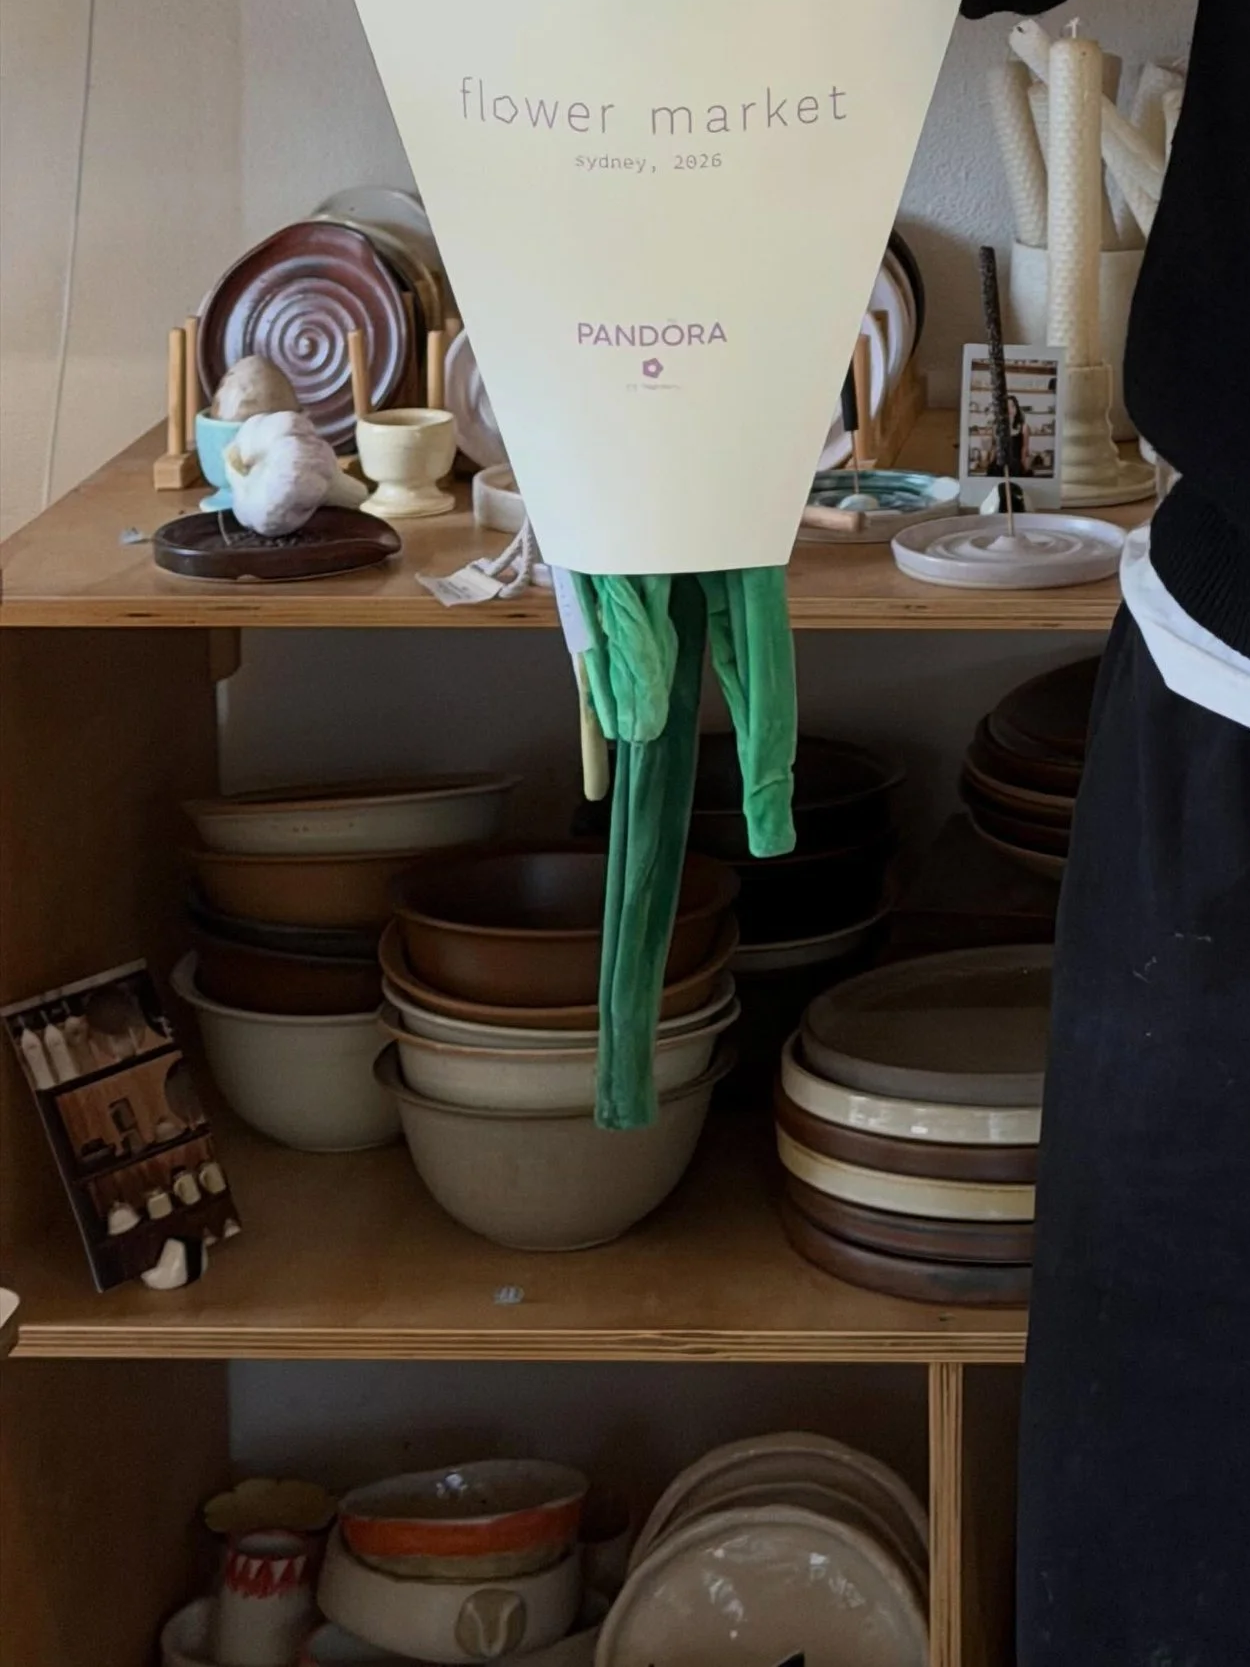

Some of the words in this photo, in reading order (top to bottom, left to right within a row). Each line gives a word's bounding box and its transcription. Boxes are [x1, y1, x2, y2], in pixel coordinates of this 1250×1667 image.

[460, 76, 615, 134] flower
[651, 86, 847, 135] market
[574, 153, 657, 174] sydney,
[673, 152, 723, 170] 2026
[577, 319, 728, 347] PANDORA
